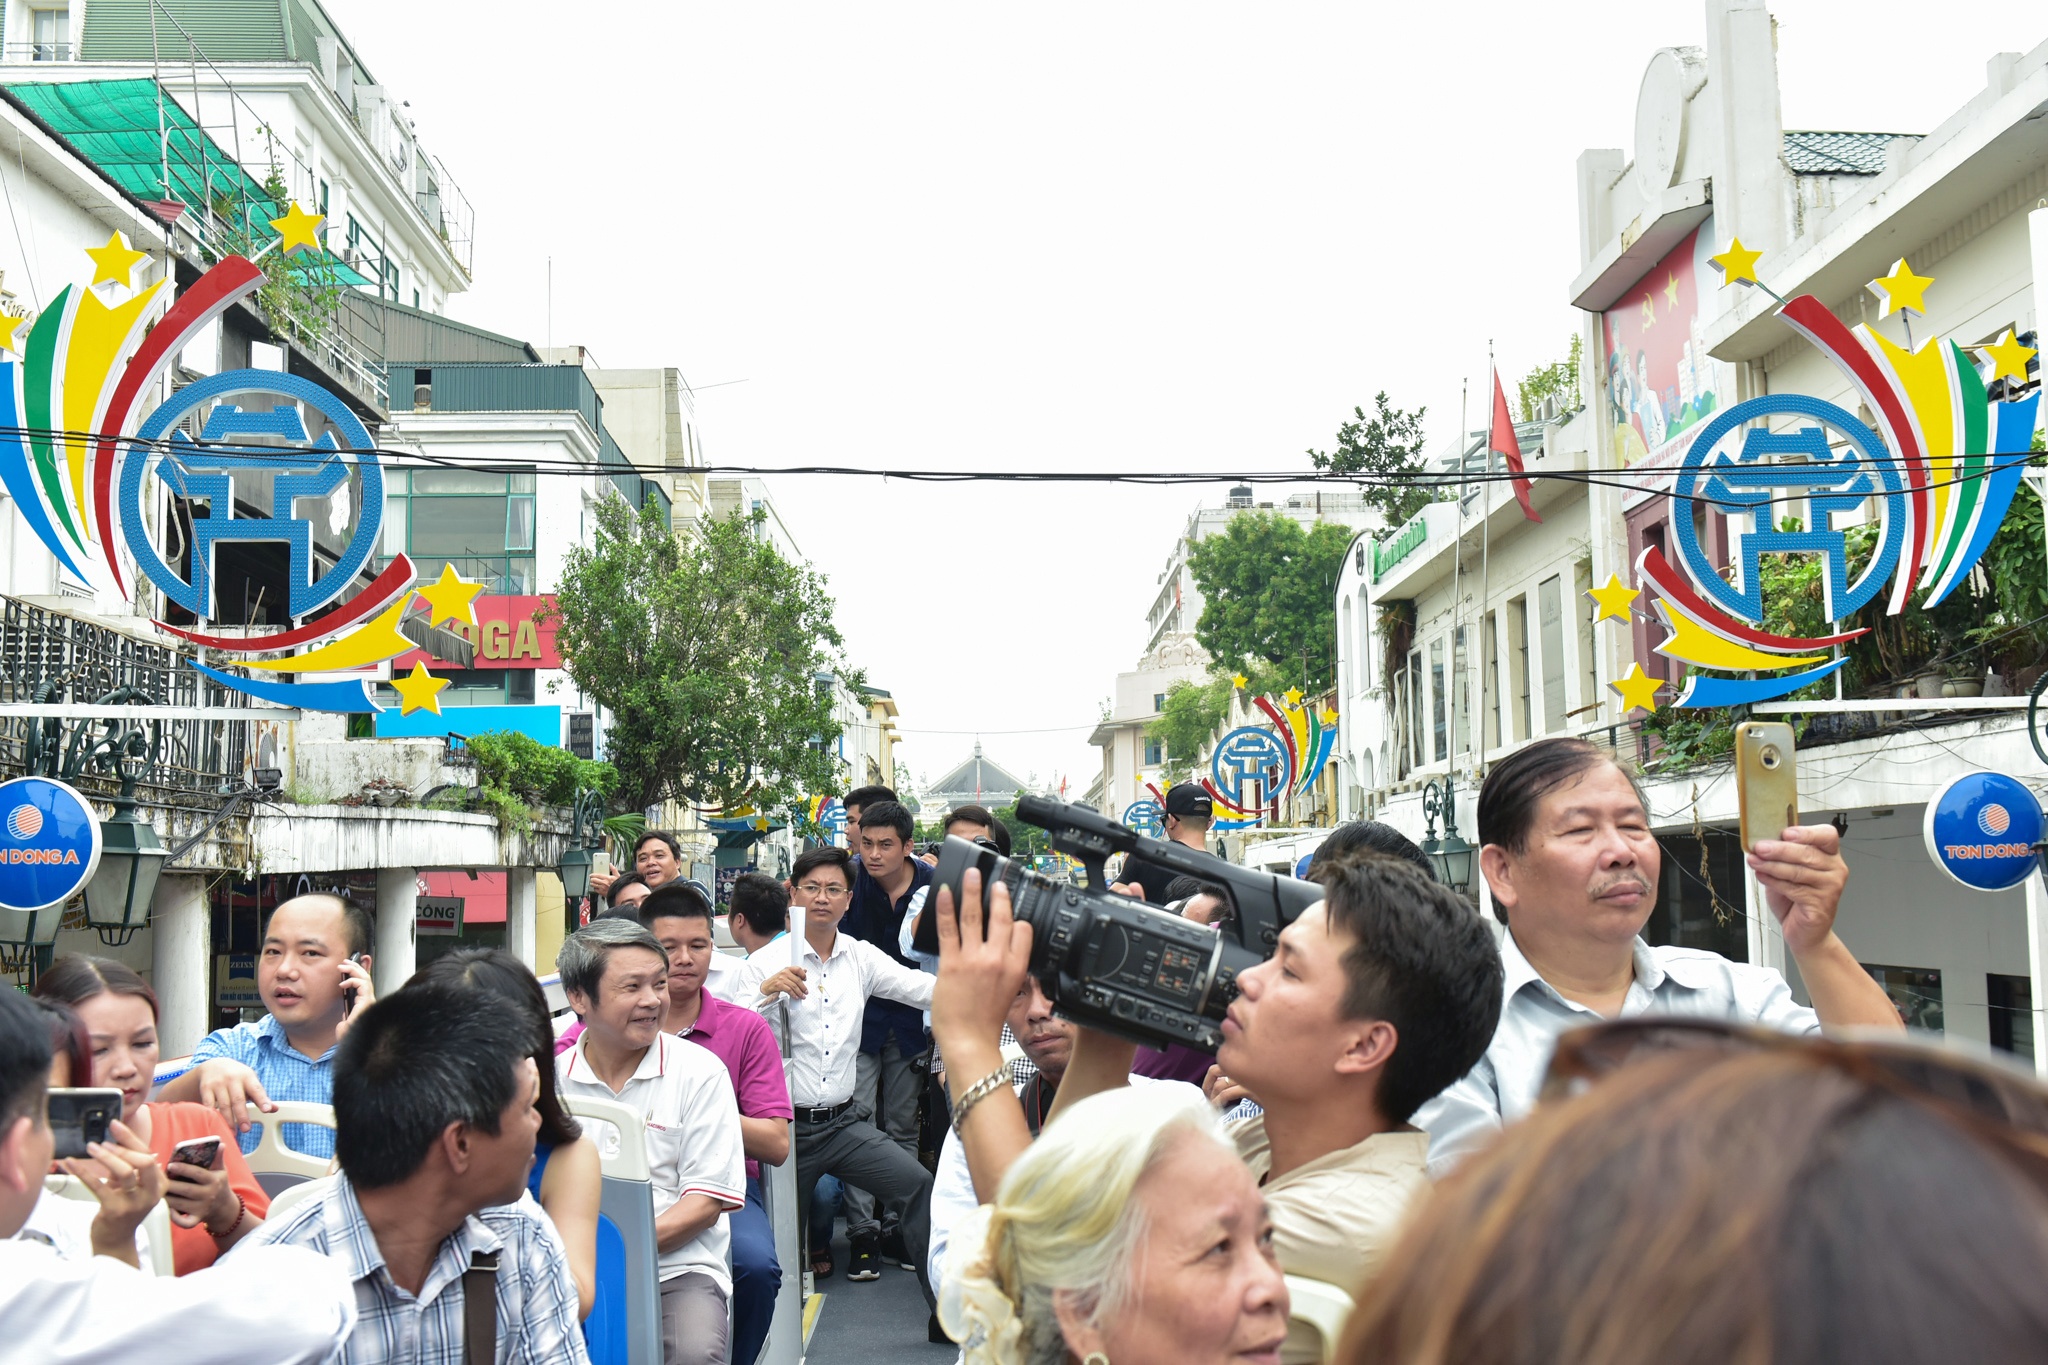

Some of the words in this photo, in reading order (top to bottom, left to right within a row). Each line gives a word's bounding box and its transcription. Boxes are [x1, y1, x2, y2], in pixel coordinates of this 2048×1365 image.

[431, 619, 542, 660] OGA
[9, 848, 63, 865] DONG
[1944, 845, 1982, 860] TON
[1983, 842, 2029, 859] DONG
[230, 961, 254, 969] ZEISS
